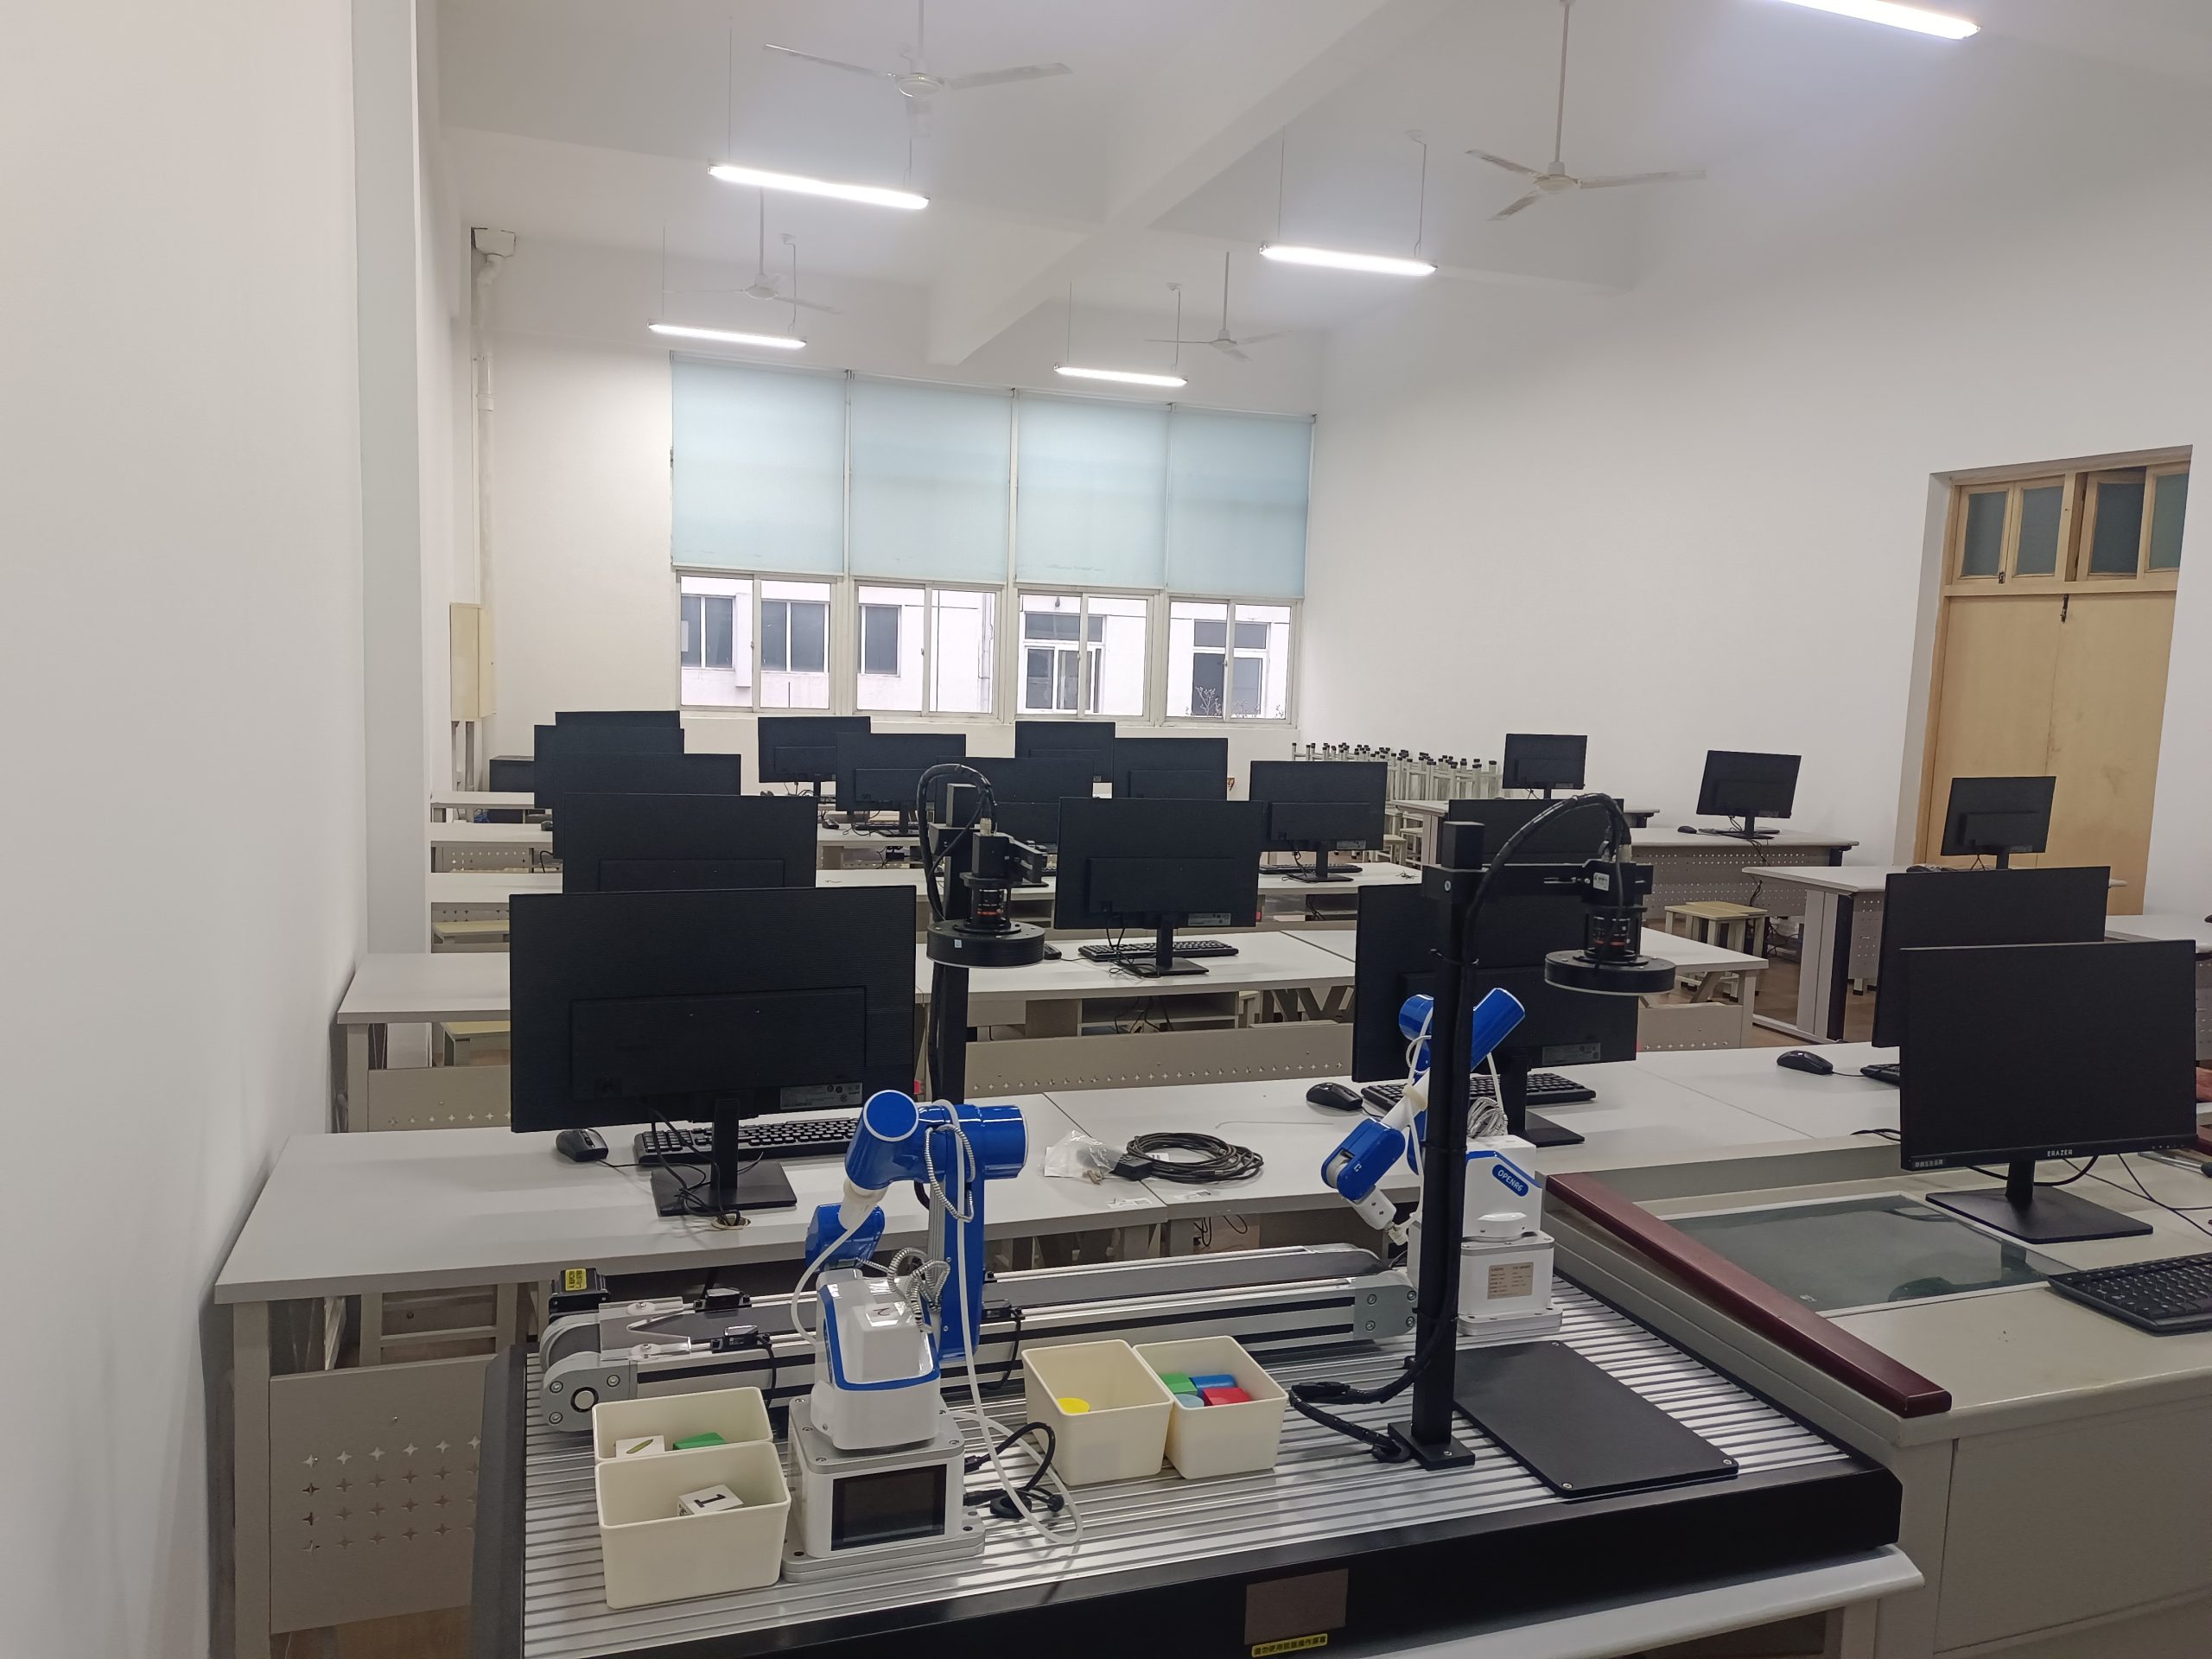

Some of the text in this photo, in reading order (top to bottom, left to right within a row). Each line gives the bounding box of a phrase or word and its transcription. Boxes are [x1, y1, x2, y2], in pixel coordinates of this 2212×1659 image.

[2047, 1148, 2073, 1157] ERAZER
[1497, 1169, 1523, 1192] OPENR6
[693, 1493, 727, 1508] 1
